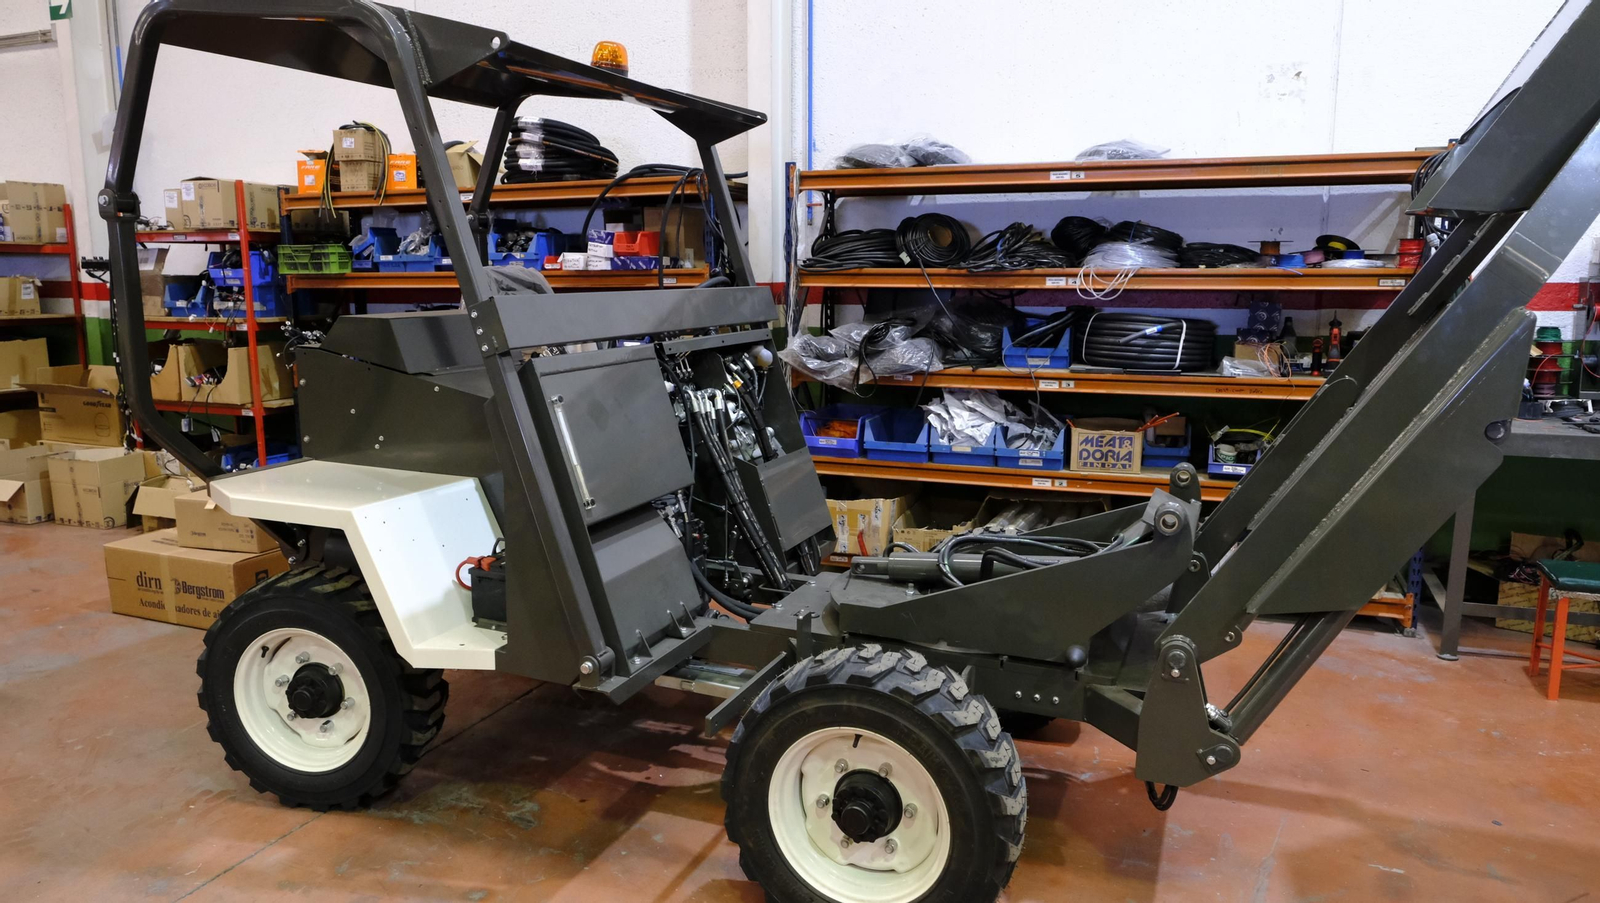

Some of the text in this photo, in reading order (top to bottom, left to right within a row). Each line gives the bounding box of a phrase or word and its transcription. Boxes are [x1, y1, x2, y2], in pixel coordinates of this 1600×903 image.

[82, 400, 112, 408] GOODYEAR
[1079, 448, 1133, 463] DORIA
[181, 581, 225, 599] Bergstrom
[202, 607, 212, 618] de
